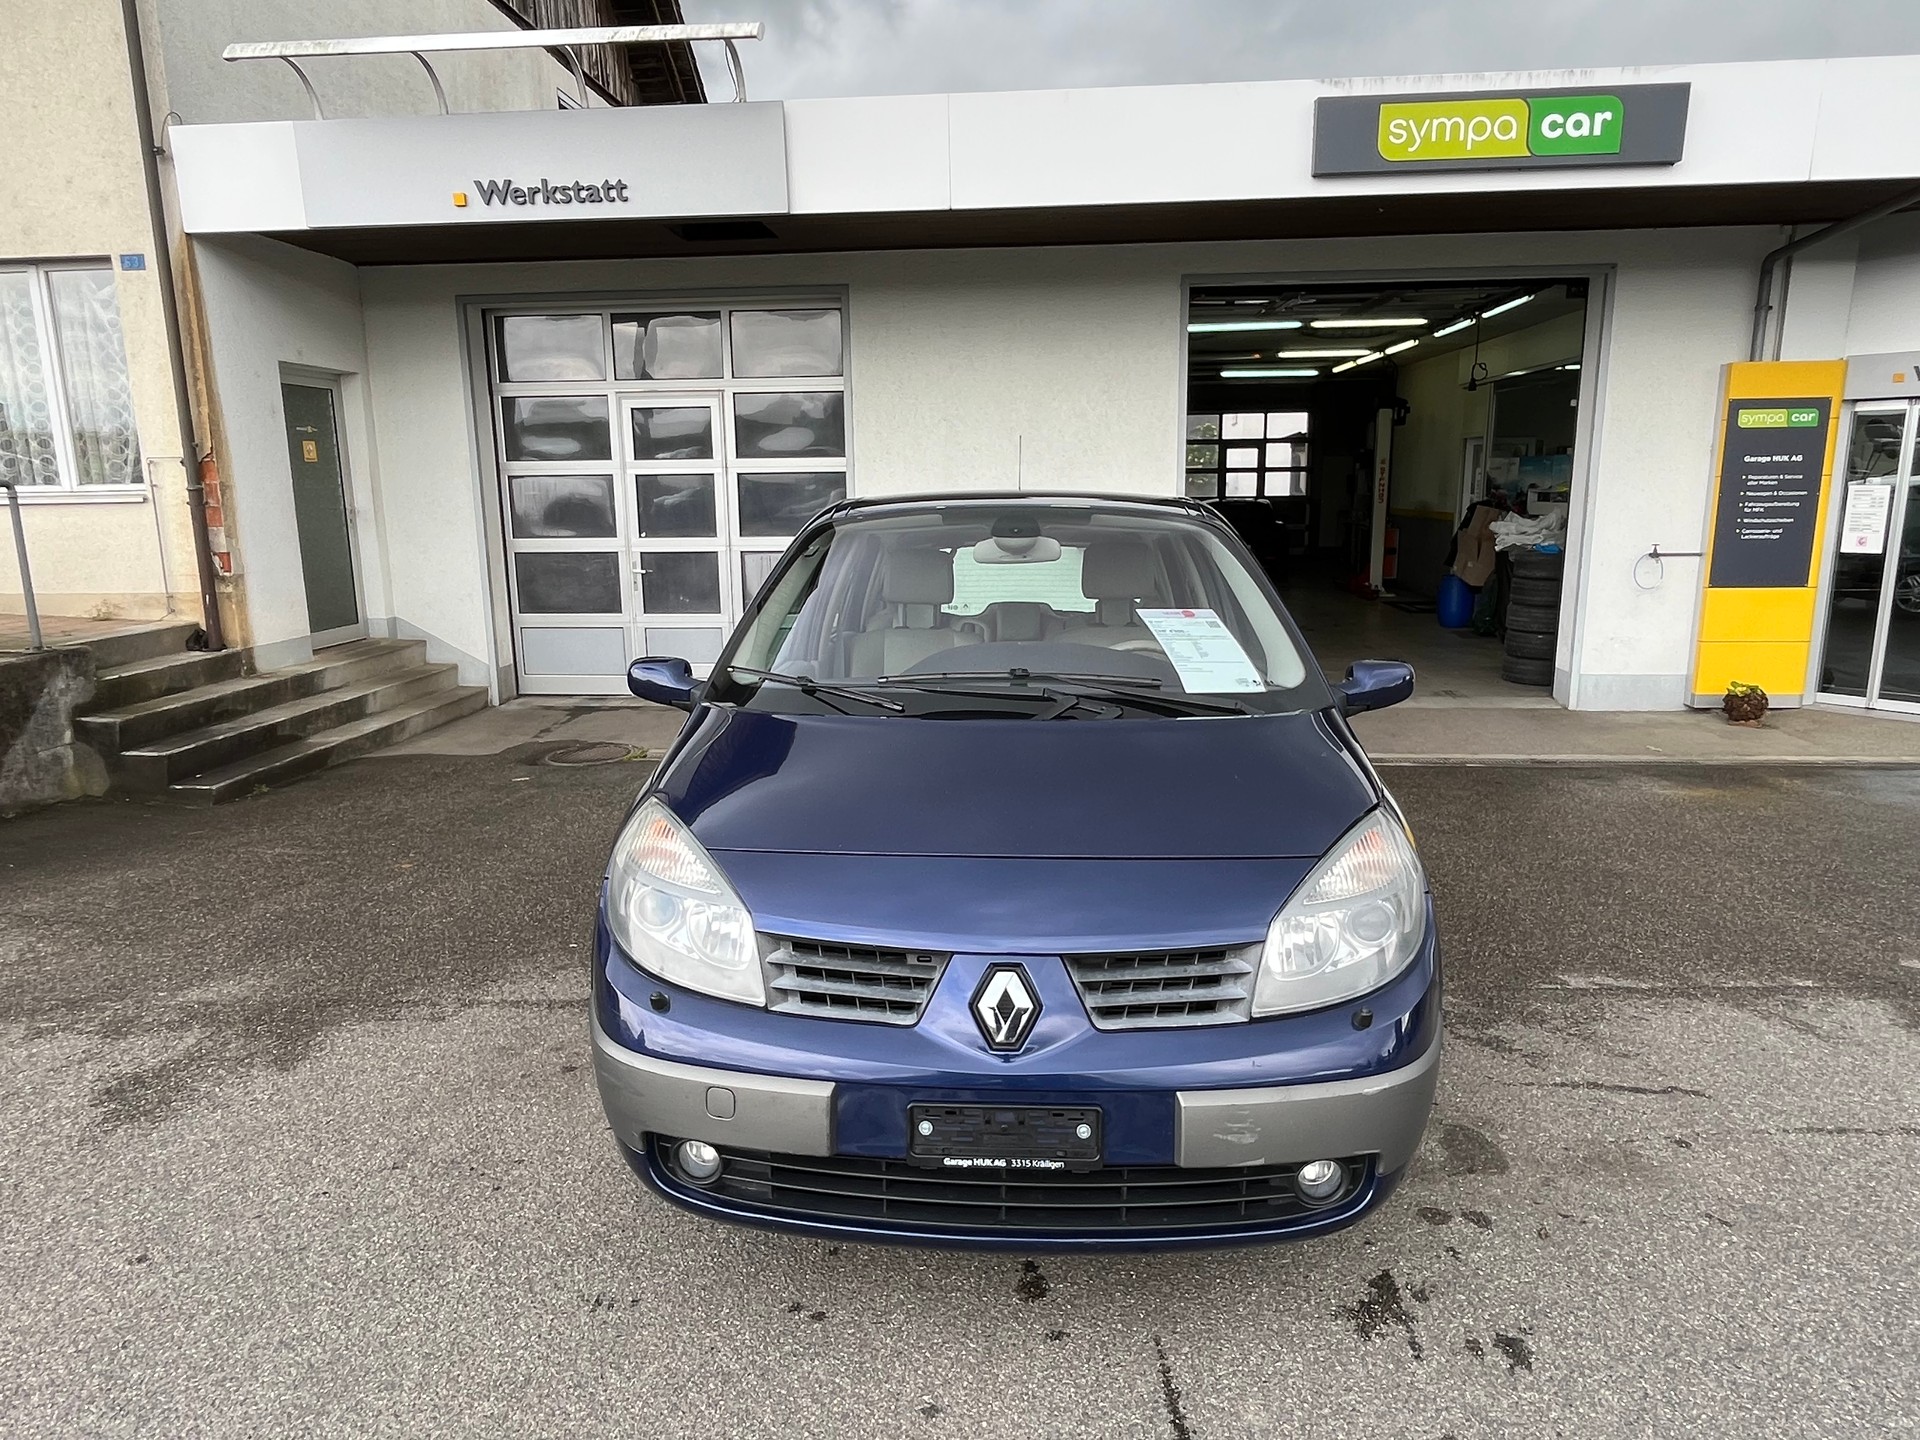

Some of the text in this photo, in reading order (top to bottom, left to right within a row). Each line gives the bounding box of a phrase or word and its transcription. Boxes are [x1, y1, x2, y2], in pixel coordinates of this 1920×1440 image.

[1388, 110, 1613, 152] sympa car
[473, 178, 629, 206] Werkstatt
[1741, 411, 1816, 425] sympa car
[1743, 454, 1803, 463] Garage HUK AG
[943, 1157, 973, 1168] Garage
[973, 1158, 993, 1167] HUK
[993, 1158, 1007, 1167] AG
[1011, 1159, 1031, 1167] 3315
